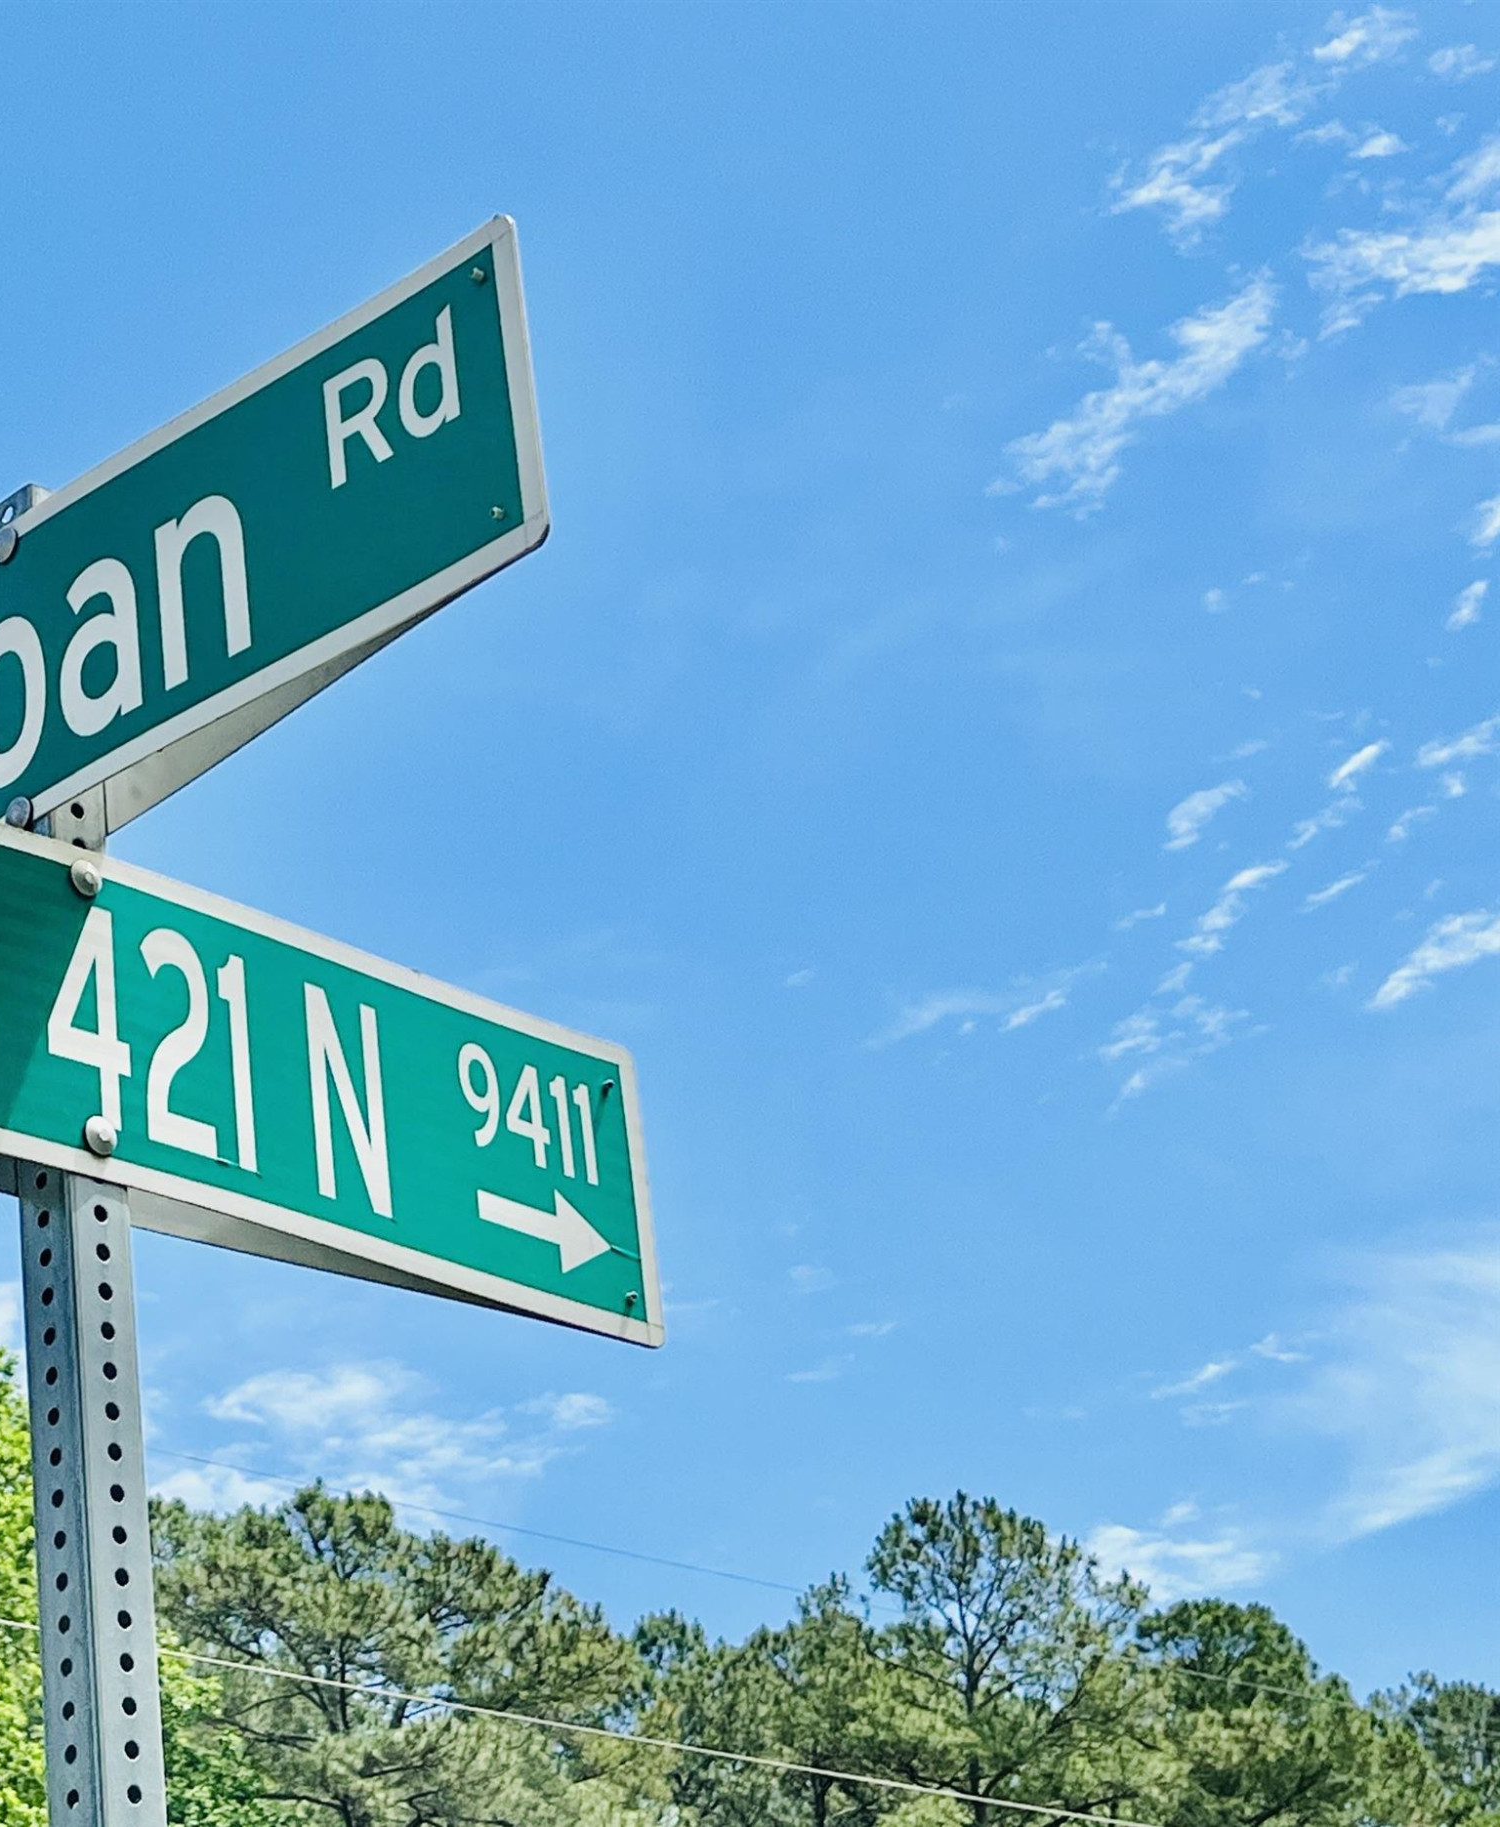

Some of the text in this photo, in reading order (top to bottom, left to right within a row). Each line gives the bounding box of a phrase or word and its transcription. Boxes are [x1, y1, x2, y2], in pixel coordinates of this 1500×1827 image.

[322, 304, 462, 490] Rd
[47, 906, 258, 1174] 421
[303, 981, 394, 1220] N
[457, 1042, 599, 1187] 9411
